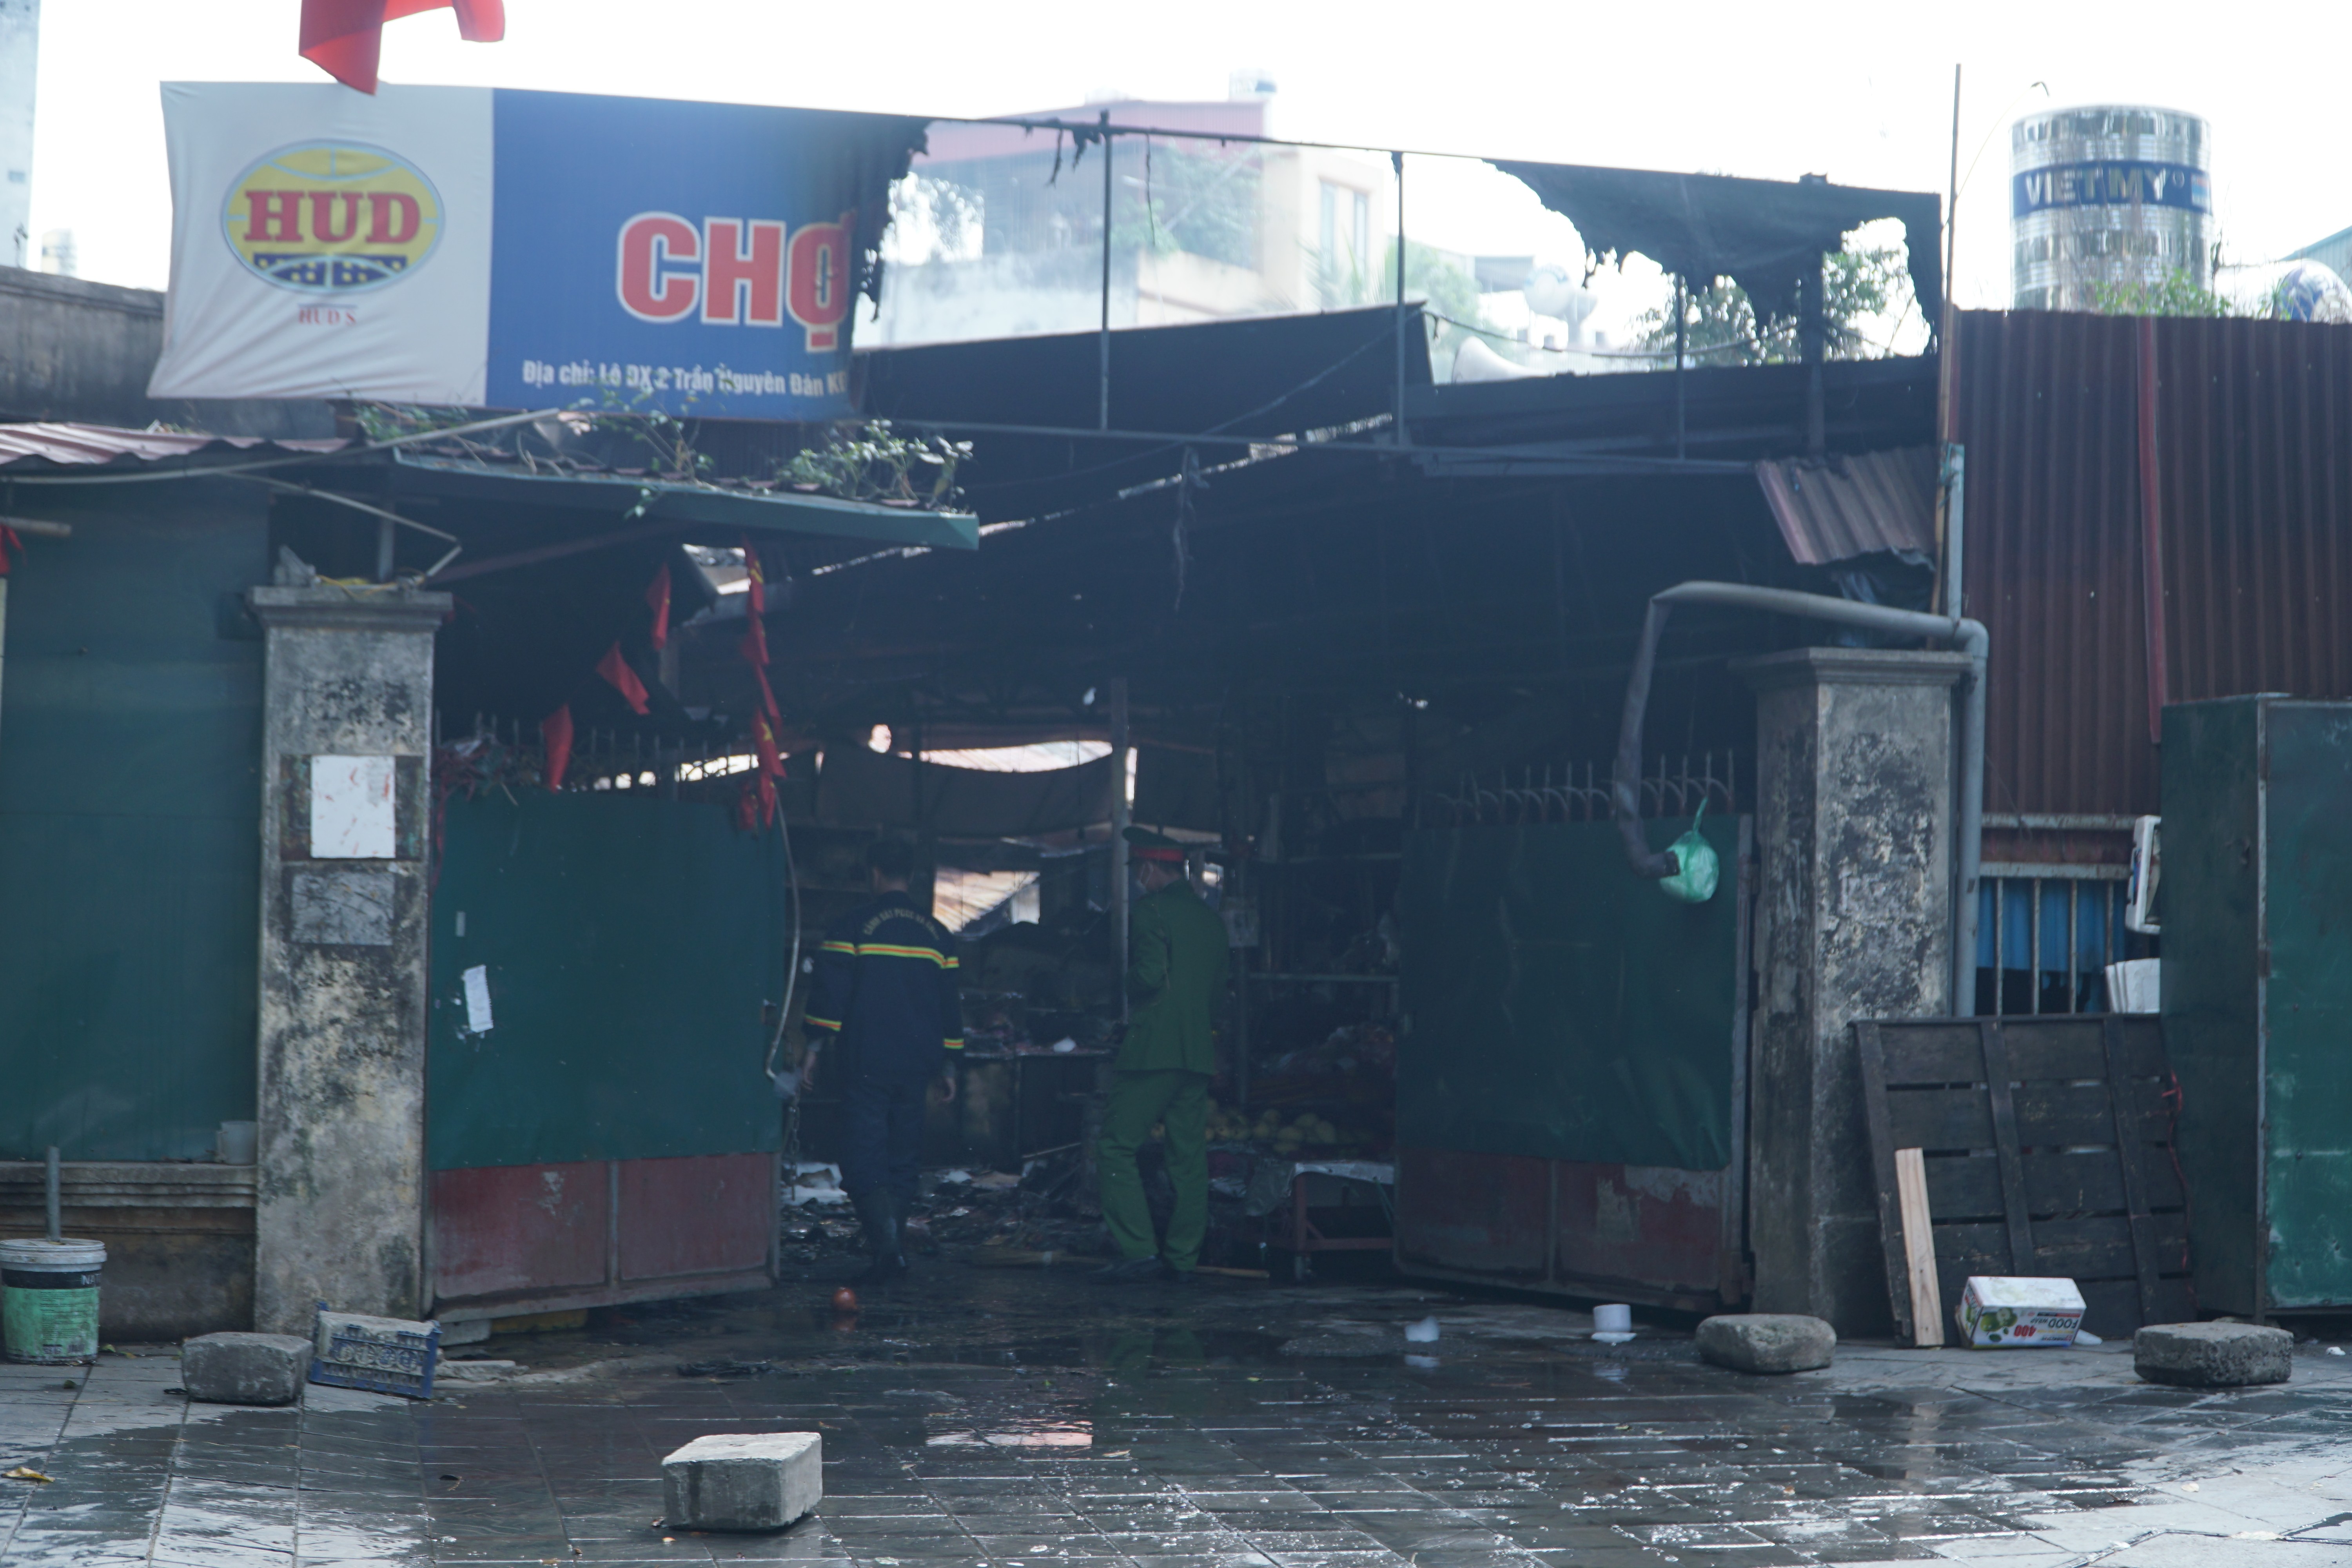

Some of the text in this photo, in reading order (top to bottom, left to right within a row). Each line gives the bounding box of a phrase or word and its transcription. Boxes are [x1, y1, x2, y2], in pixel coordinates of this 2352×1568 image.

[243, 190, 421, 244] HUD
[523, 360, 555, 389] Địa
[2014, 1325, 2037, 1337] 400
[2048, 1318, 2079, 1329] FOOD
